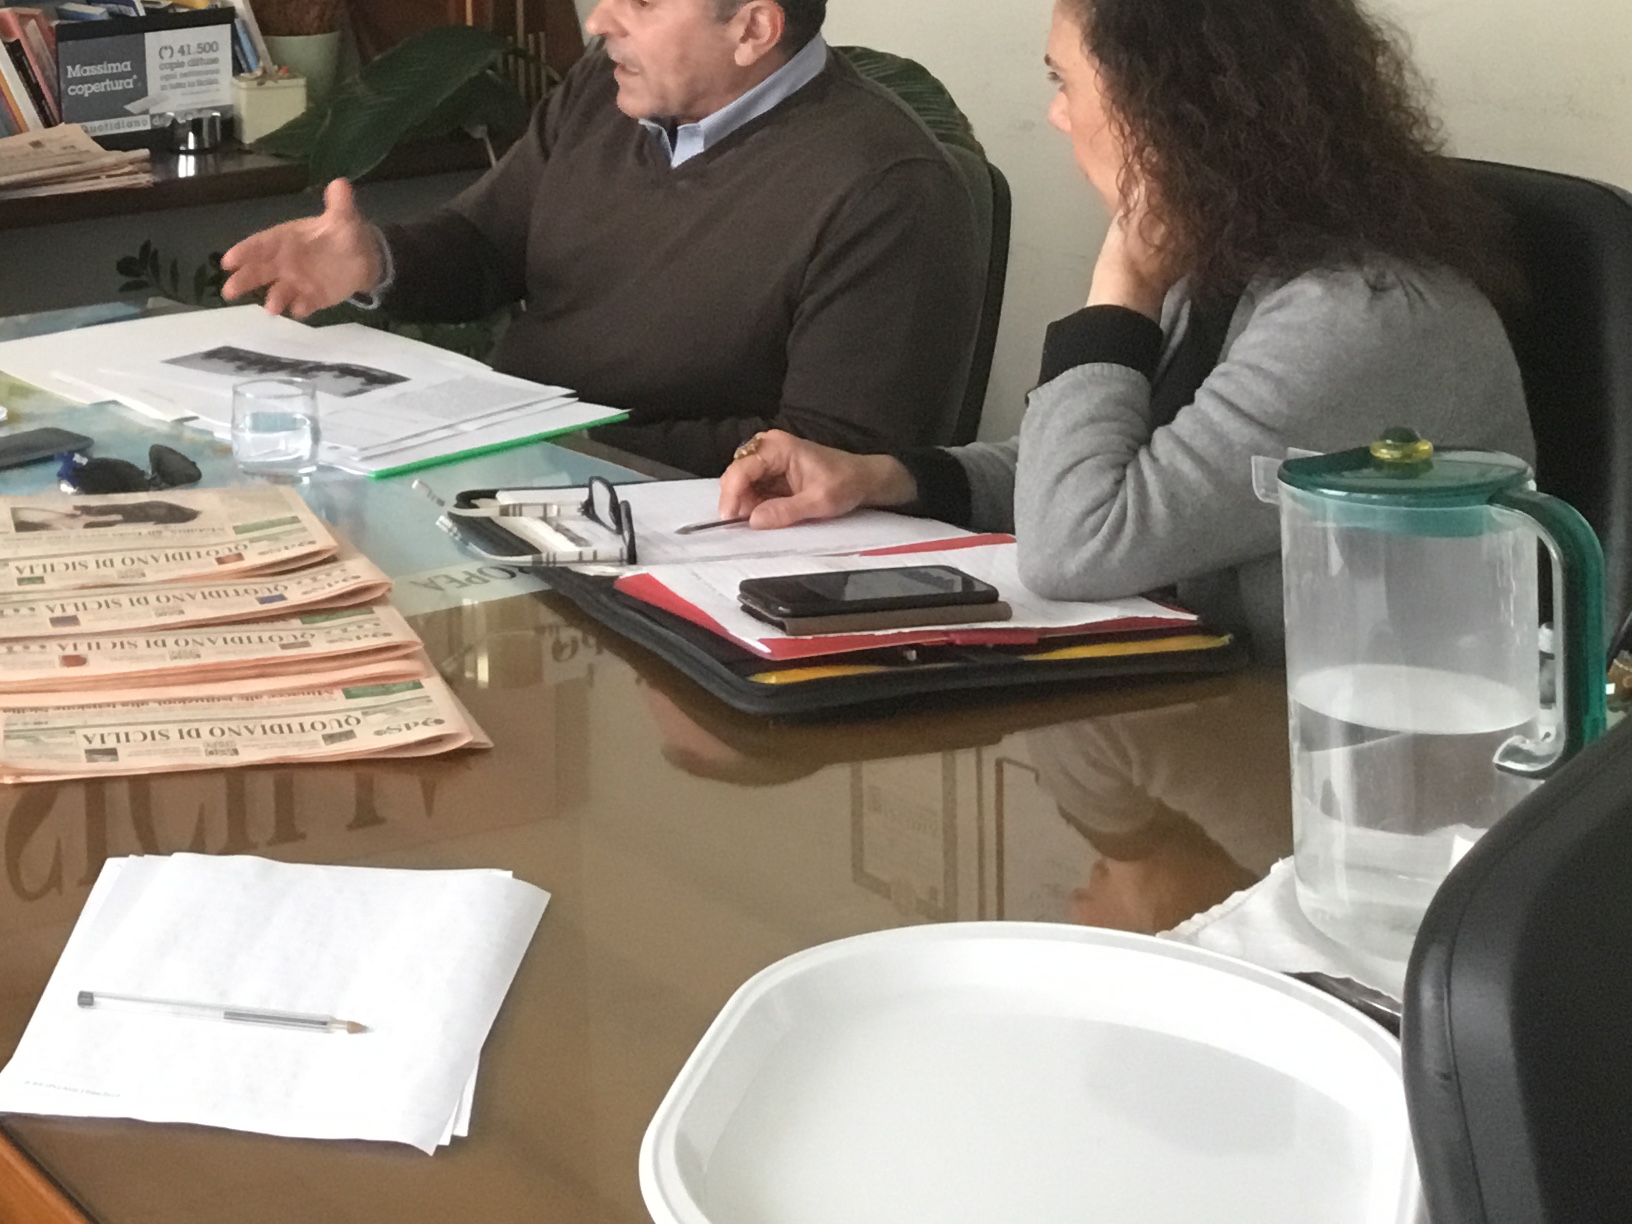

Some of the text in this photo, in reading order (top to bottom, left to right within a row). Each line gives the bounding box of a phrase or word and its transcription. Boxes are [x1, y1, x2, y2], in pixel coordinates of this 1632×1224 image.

[66, 60, 132, 78] Massima
[95, 556, 114, 568] DI
[121, 543, 249, 567] QUOTIDIANO
[14, 559, 89, 575] SICILIA
[128, 595, 150, 607] DI
[155, 583, 288, 604] QUOTIDIANO
[45, 598, 122, 614] SICILIA
[57, 639, 138, 652] SICILIA
[145, 637, 167, 648] DI
[174, 631, 316, 648] QUOTIDIANO
[177, 727, 202, 741] DI
[209, 714, 362, 738] QUOTIDIANO
[82, 729, 170, 746] SICILIA
